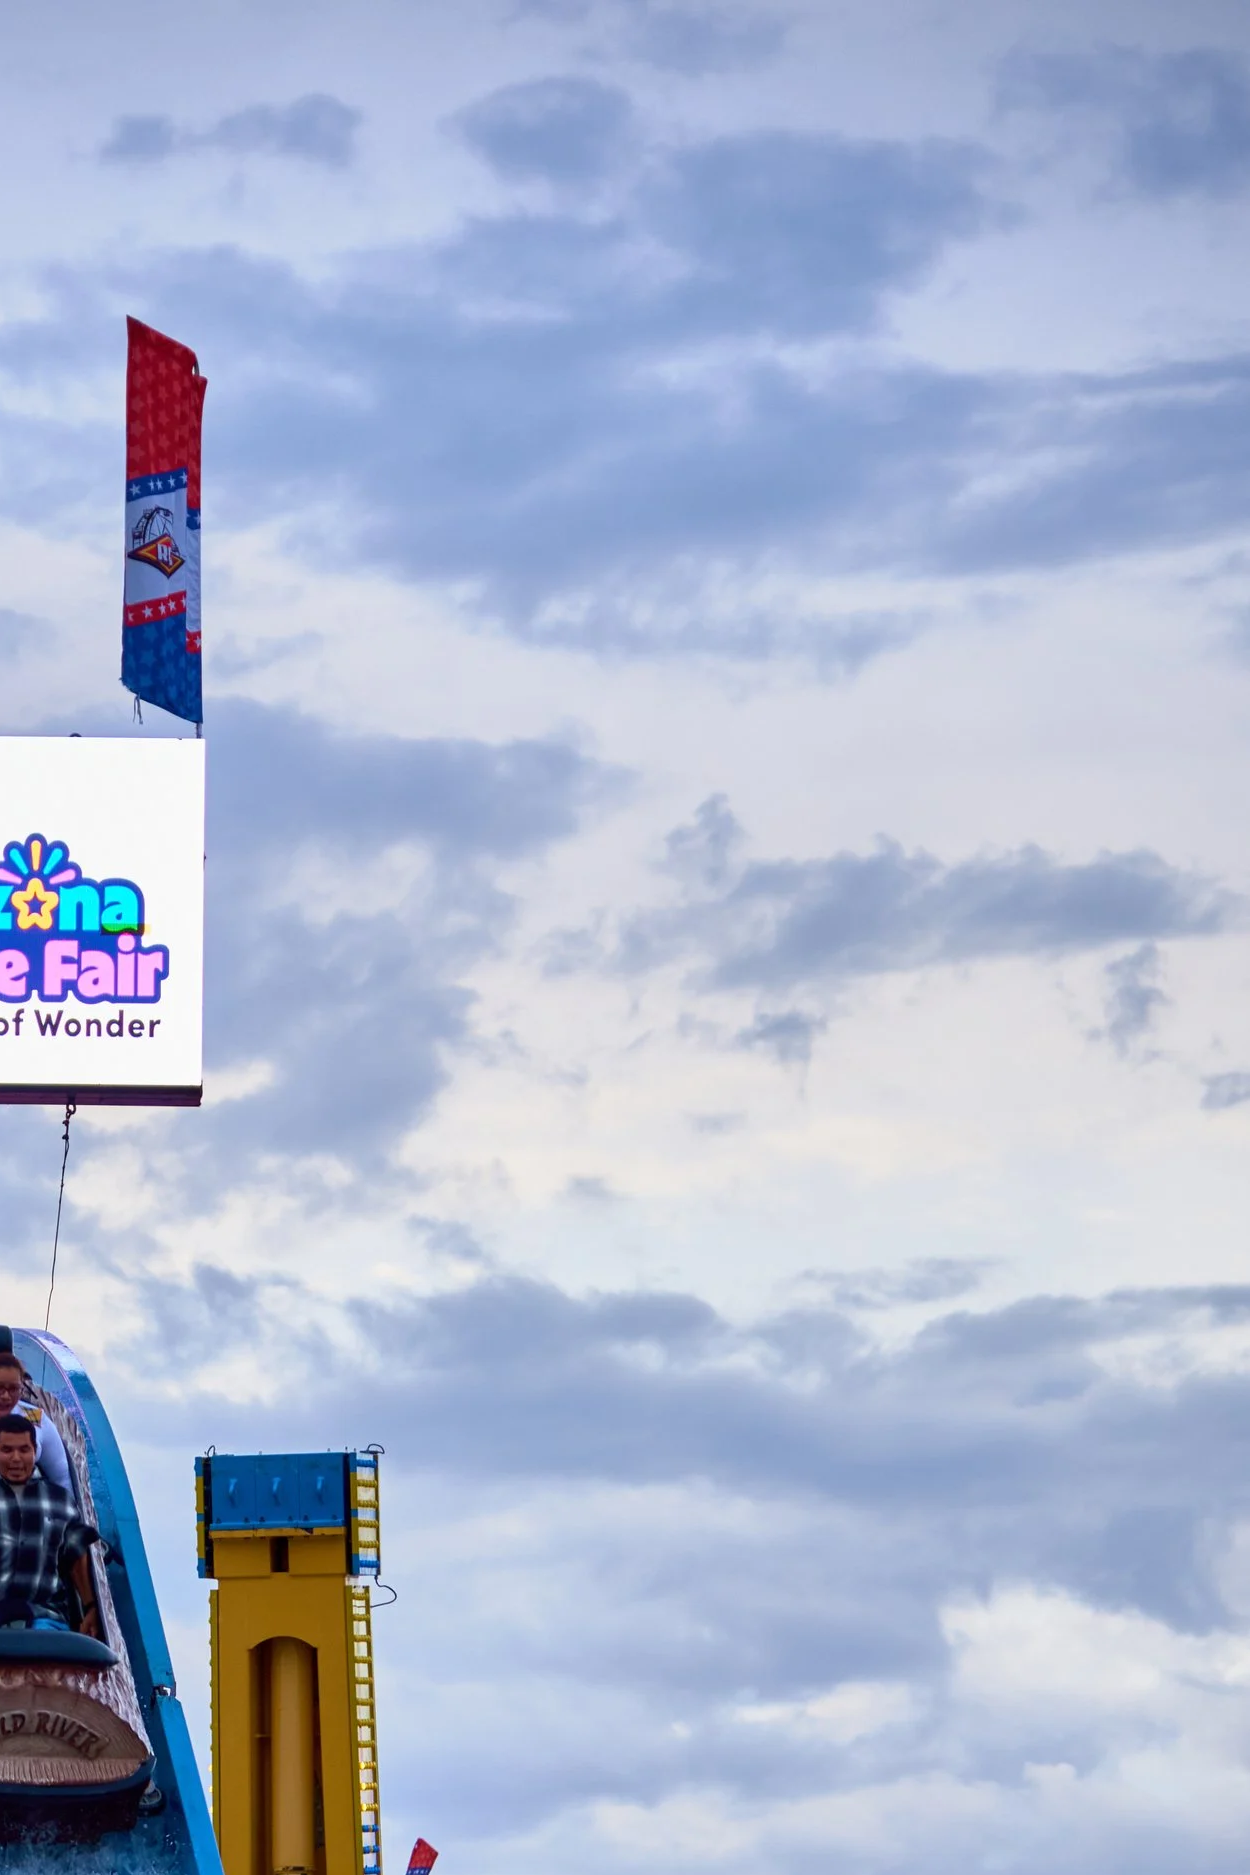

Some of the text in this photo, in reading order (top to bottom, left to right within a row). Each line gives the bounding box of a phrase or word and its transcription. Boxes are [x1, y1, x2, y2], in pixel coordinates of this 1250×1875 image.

[44, 933, 164, 999] Fair
[33, 1009, 161, 1038] Wonder
[35, 1712, 101, 1753] RIVER
